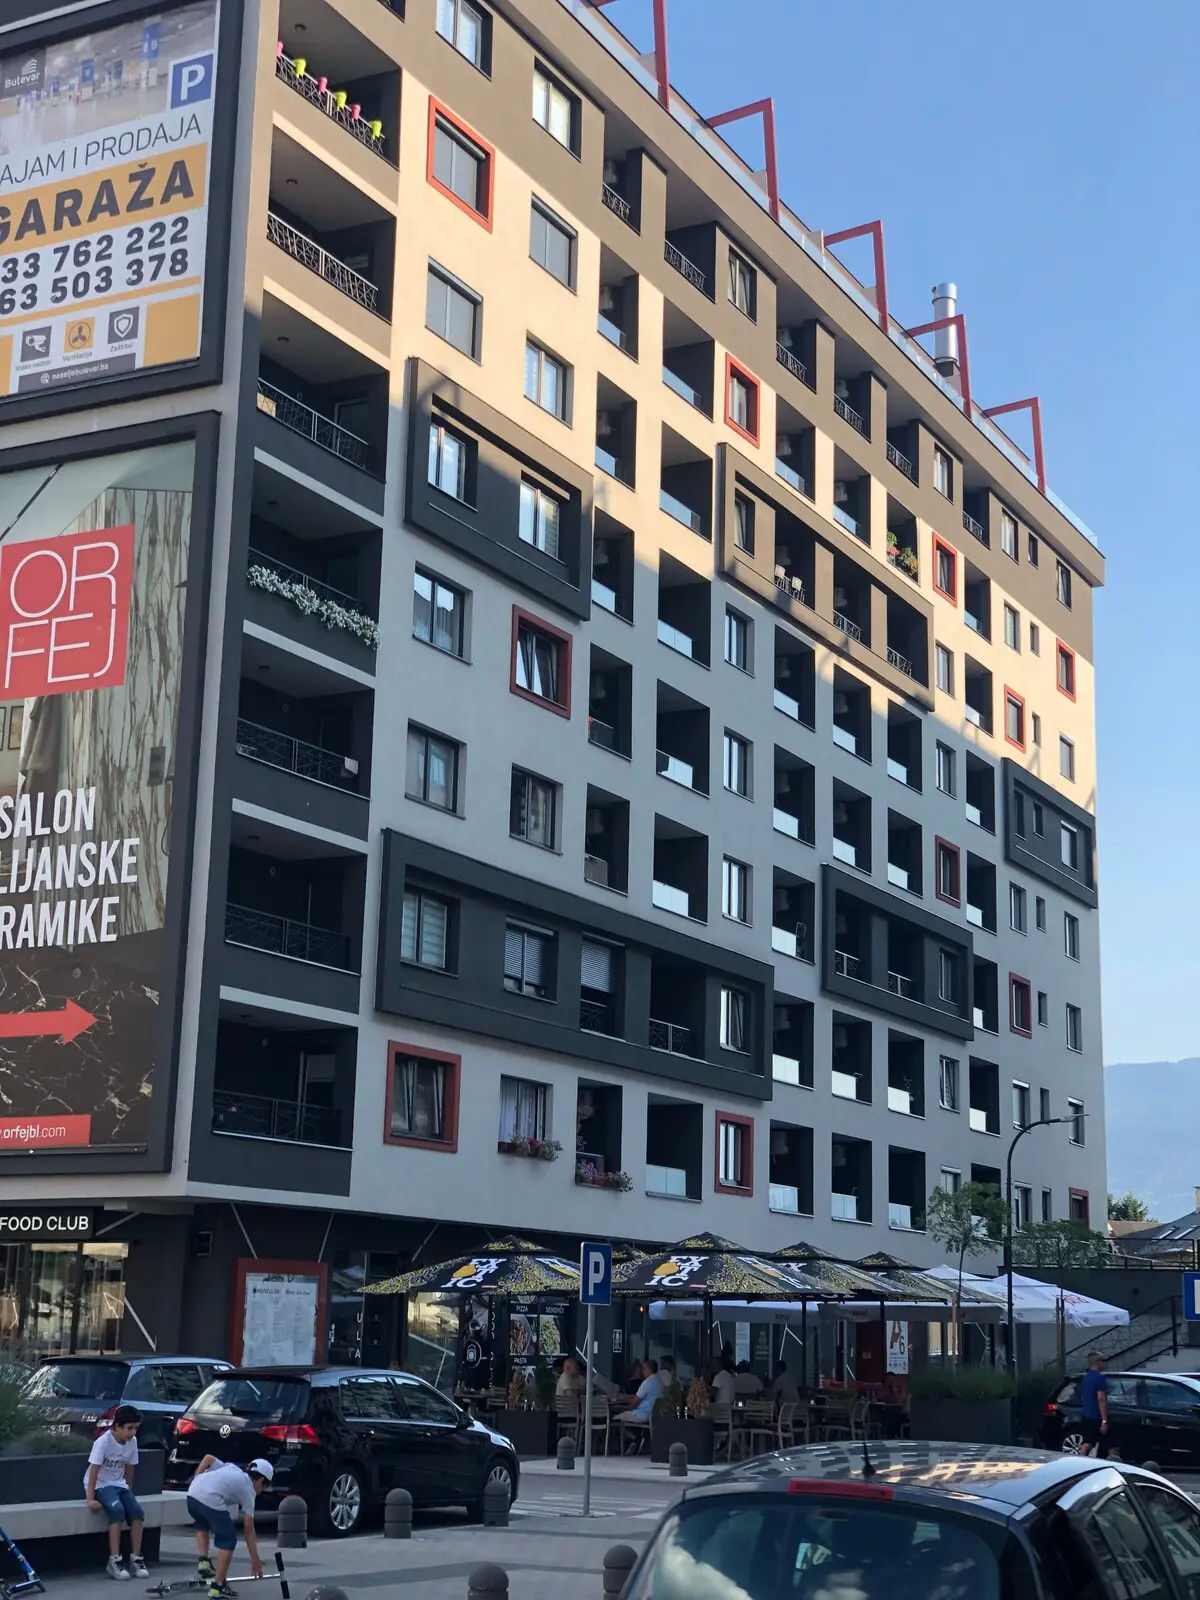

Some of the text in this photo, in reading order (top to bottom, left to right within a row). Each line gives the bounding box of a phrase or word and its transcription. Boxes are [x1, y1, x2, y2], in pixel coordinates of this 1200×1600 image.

[5, 72, 40, 88] Bulevar
[181, 64, 205, 101] P
[85, 113, 202, 166] PRODAJA
[1, 216, 189, 284] 33 762 222
[51, 265, 113, 304] 503
[126, 248, 188, 286] 378
[10, 541, 120, 618] OR
[4, 608, 117, 689] FEJ
[0, 786, 96, 840] SALON
[0, 896, 119, 950] RAMIKE
[0, 1215, 89, 1231] FOOD CLUB
[588, 1251, 605, 1296] P
